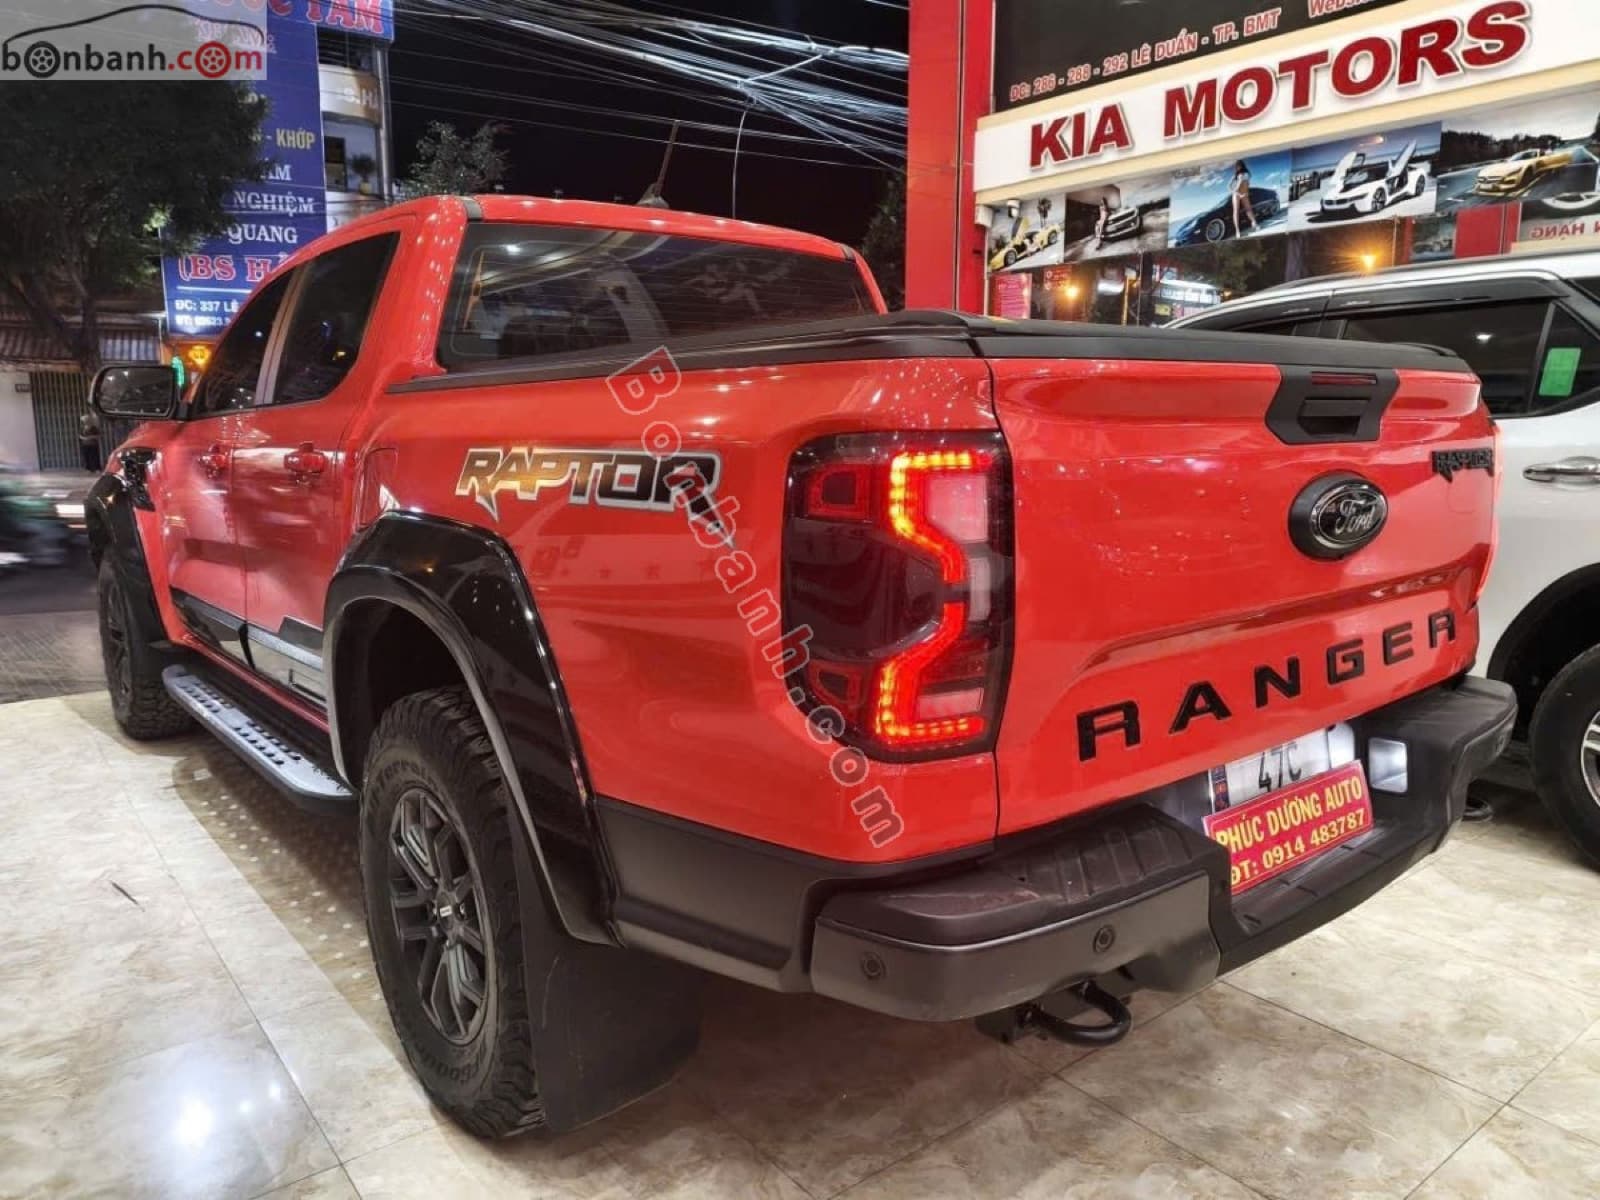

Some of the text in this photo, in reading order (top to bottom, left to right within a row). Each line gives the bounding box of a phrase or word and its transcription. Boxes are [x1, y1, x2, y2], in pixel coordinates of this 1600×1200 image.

[1102, 53, 1129, 77] 292
[1212, 23, 1239, 45] TP.
[1243, 8, 1282, 35] BMT
[1029, 0, 1531, 169] KIA MOTORS
[276, 127, 316, 149] KHỚP
[233, 191, 314, 217] NGHIỆM
[227, 224, 299, 245] QUANG
[178, 255, 237, 282] (BS
[200, 300, 220, 312] 337
[455, 444, 737, 548] RAPTOR
[1334, 499, 1378, 534] Ford
[1075, 608, 1457, 763] RANGER
[1215, 813, 1265, 854] PHÚC
[1324, 775, 1363, 812] AUTO
[1262, 835, 1306, 870] 0914
[1309, 807, 1366, 847] 483787
